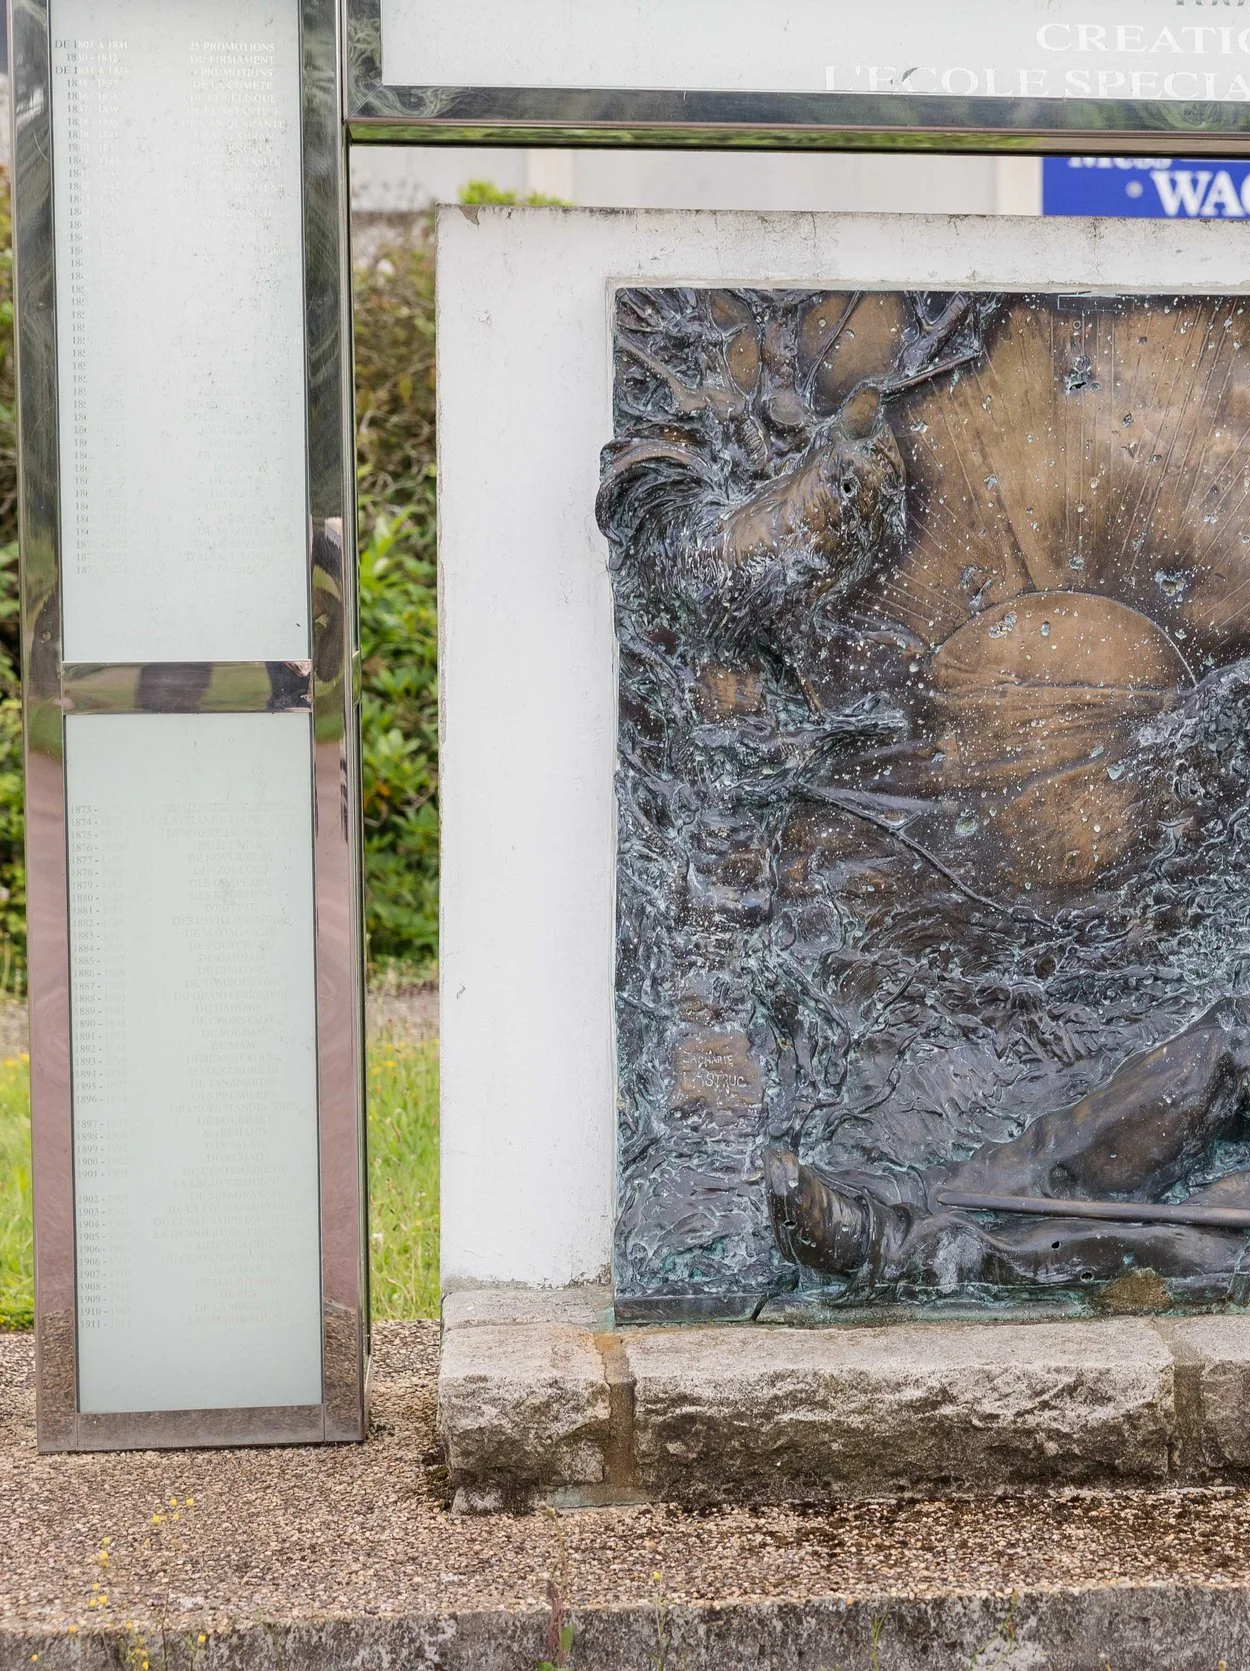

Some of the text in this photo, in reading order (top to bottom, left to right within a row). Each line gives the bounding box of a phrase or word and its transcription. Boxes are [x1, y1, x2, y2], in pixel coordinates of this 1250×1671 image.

[203, 42, 276, 52] PROMOTIONS
[55, 66, 70, 75] DE
[72, 805, 91, 814] 1873
[72, 818, 91, 827] 1874
[72, 830, 91, 839] 1875
[73, 843, 92, 852] 1876
[73, 856, 92, 864] 1877
[73, 868, 92, 877] 1878
[73, 881, 92, 890] 1879
[74, 894, 93, 902] 1880
[74, 906, 93, 915] 1881
[74, 919, 93, 928] 1882
[74, 932, 94, 940] 1883
[74, 944, 94, 953] 1884
[74, 957, 94, 965] 1885
[75, 970, 95, 978] 1886
[75, 982, 95, 991] 1887
[75, 995, 95, 1003] 1888
[75, 1008, 95, 1016] 1889
[76, 1020, 96, 1029] 1890
[76, 1033, 96, 1041] 1891
[76, 1046, 96, 1054] 1892
[76, 1058, 96, 1066] 1893
[76, 1070, 96, 1079] 1894
[77, 1083, 97, 1091] 1895
[77, 1096, 97, 1104] 1896
[78, 1120, 97, 1128] 1897
[78, 1132, 97, 1141] 1898
[78, 1145, 98, 1154] 1899
[78, 1158, 98, 1166] 1900
[78, 1170, 98, 1178] 1901
[80, 1196, 100, 1204] 1902
[80, 1208, 100, 1216] 1903
[80, 1220, 100, 1229] 1904
[80, 1233, 100, 1241] 1905
[80, 1245, 100, 1254] 1906
[80, 1258, 100, 1266] 1906
[81, 1270, 101, 1279] 1907
[81, 1283, 101, 1291] 1908
[81, 1295, 101, 1304] 1909
[81, 1308, 101, 1316] 1910
[82, 1320, 102, 1328] 1911
